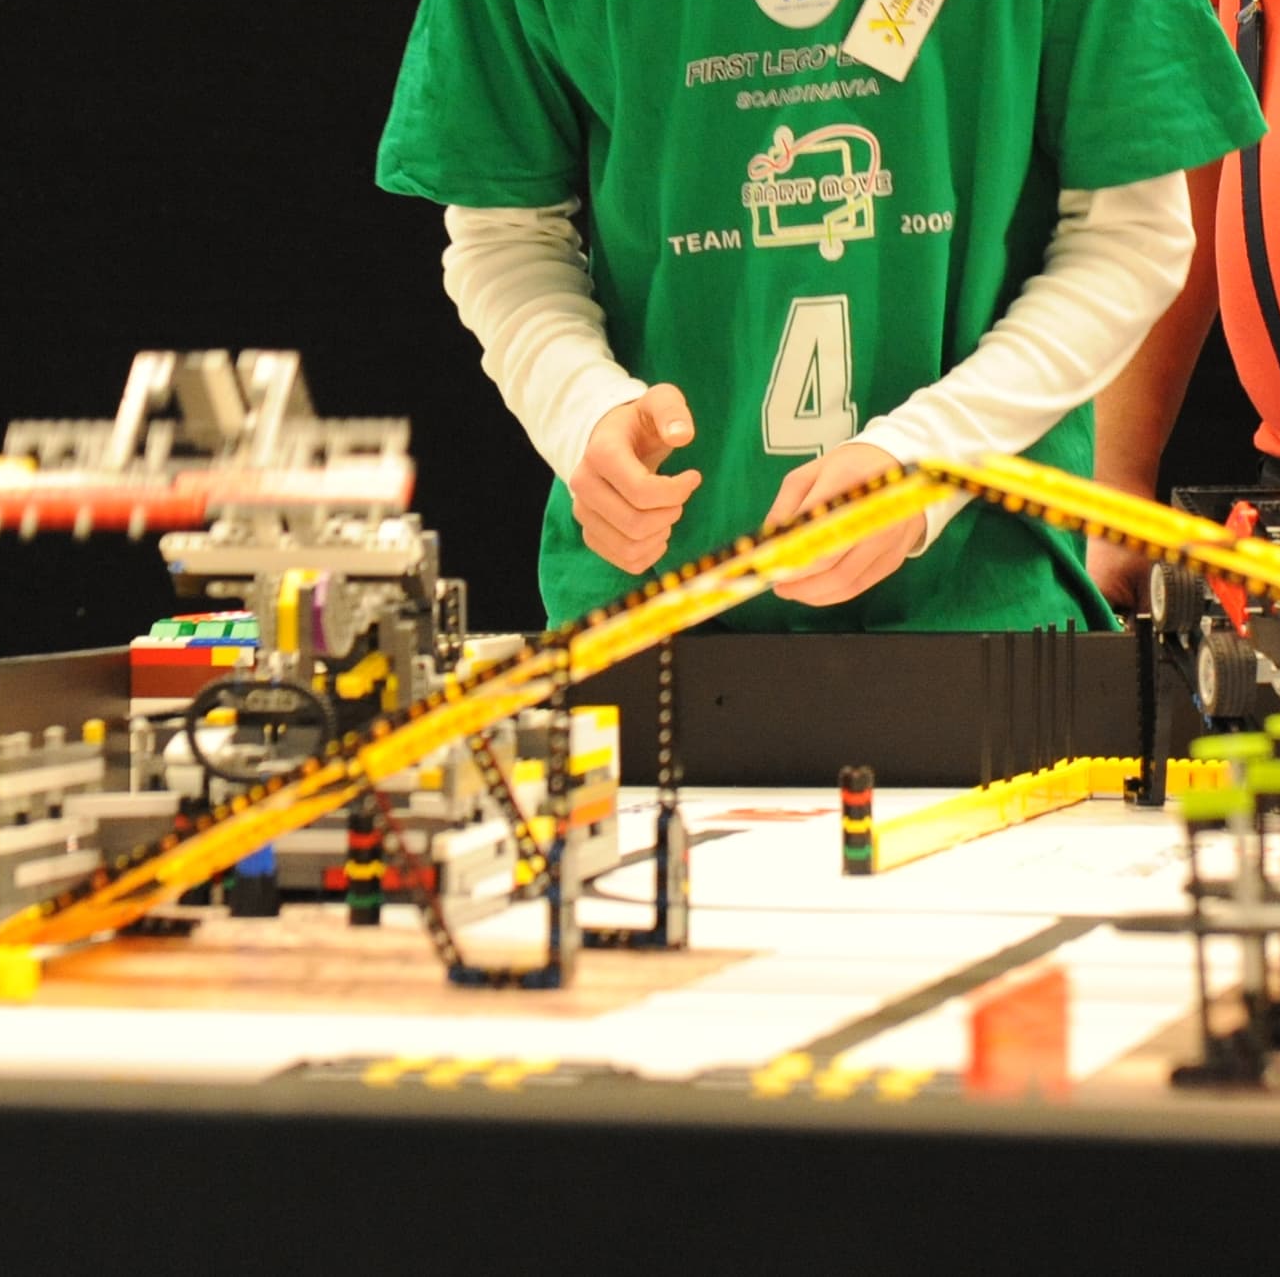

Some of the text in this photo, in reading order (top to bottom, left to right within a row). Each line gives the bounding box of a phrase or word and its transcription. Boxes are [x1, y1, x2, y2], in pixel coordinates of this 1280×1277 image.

[685, 51, 759, 88] FIRST
[763, 44, 830, 77] LEGO
[736, 76, 881, 110] SCANDINAVIA
[901, 211, 953, 234] 2009
[669, 230, 742, 256] TEAM
[762, 293, 858, 458] 4
